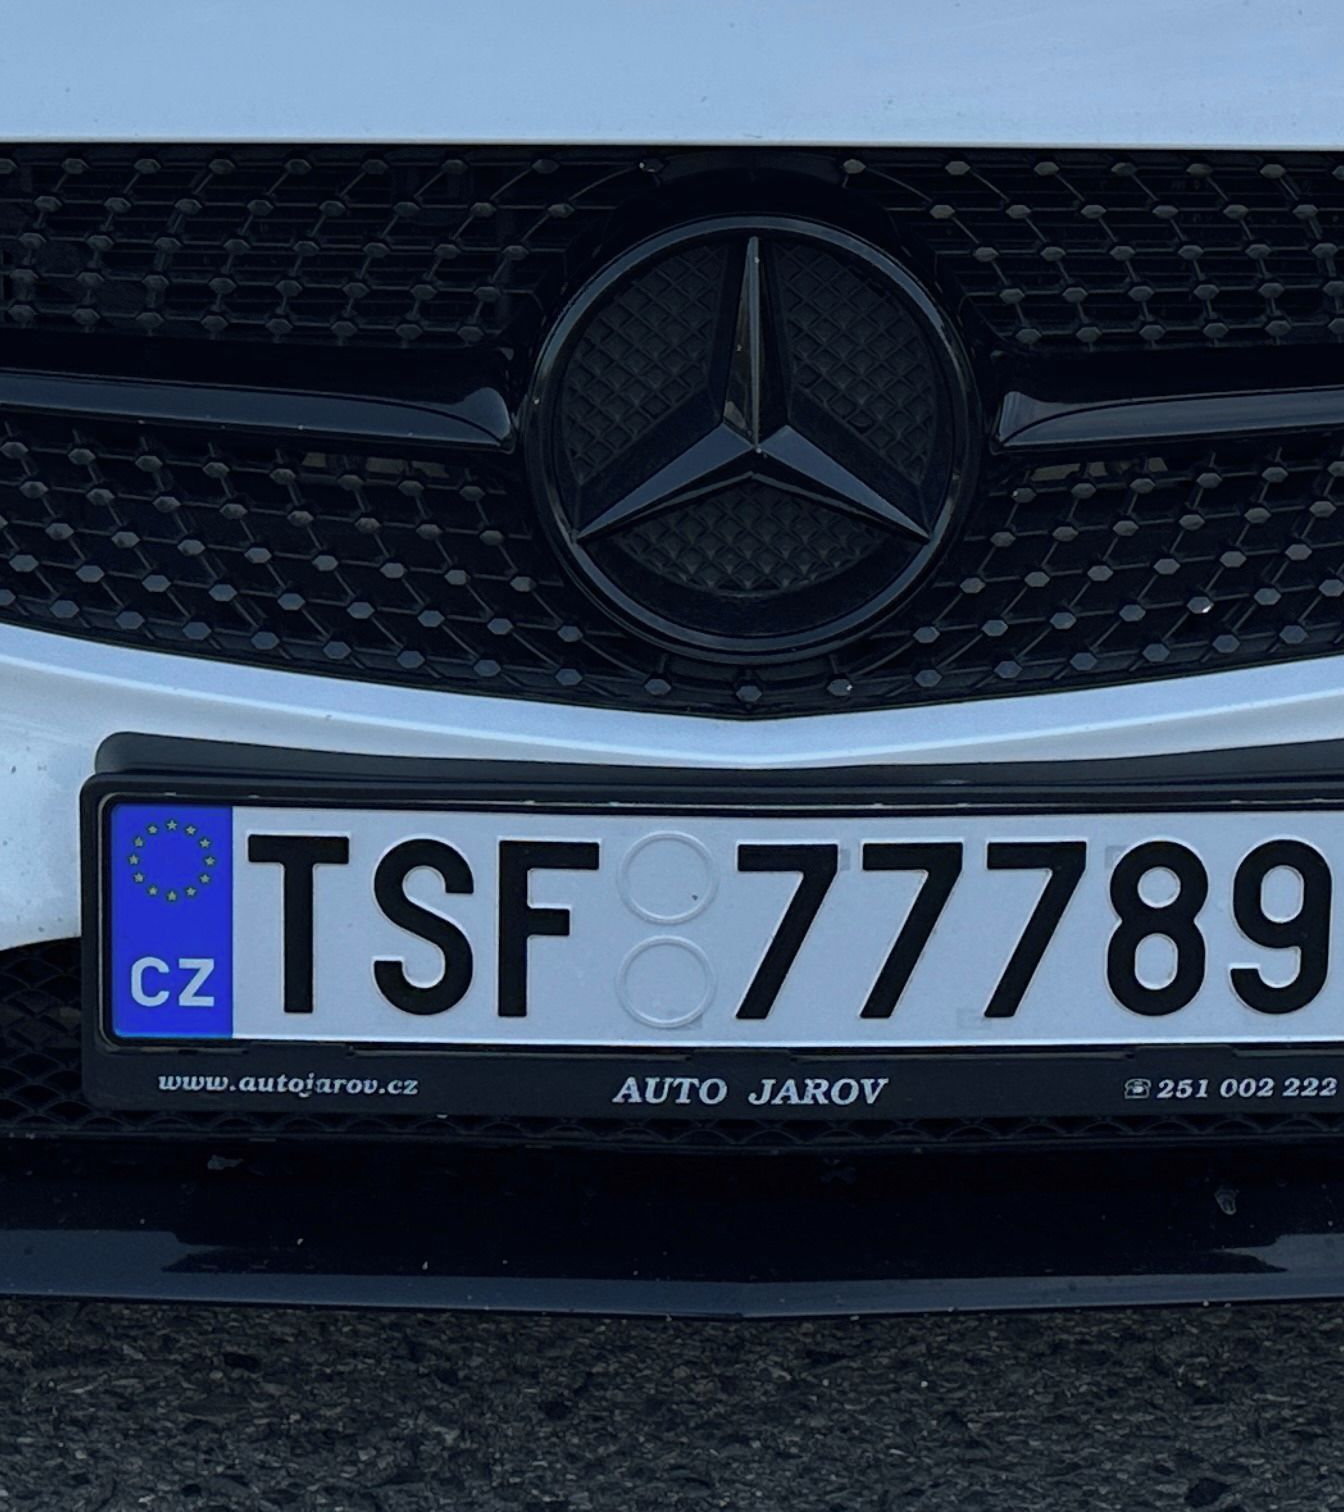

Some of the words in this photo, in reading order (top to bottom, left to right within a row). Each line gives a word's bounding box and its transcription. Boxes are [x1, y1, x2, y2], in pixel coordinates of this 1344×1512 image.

[247, 833, 600, 1018] TSF
[735, 839, 1333, 1020] 77789
[130, 956, 216, 1008] CZ
[158, 1073, 419, 1098] www.autojarov.cz
[612, 1076, 729, 1105] AUTO
[747, 1077, 890, 1106] JAROV
[1156, 1078, 1209, 1099] 251
[1219, 1077, 1275, 1098] 002
[1282, 1076, 1338, 1097] 222
